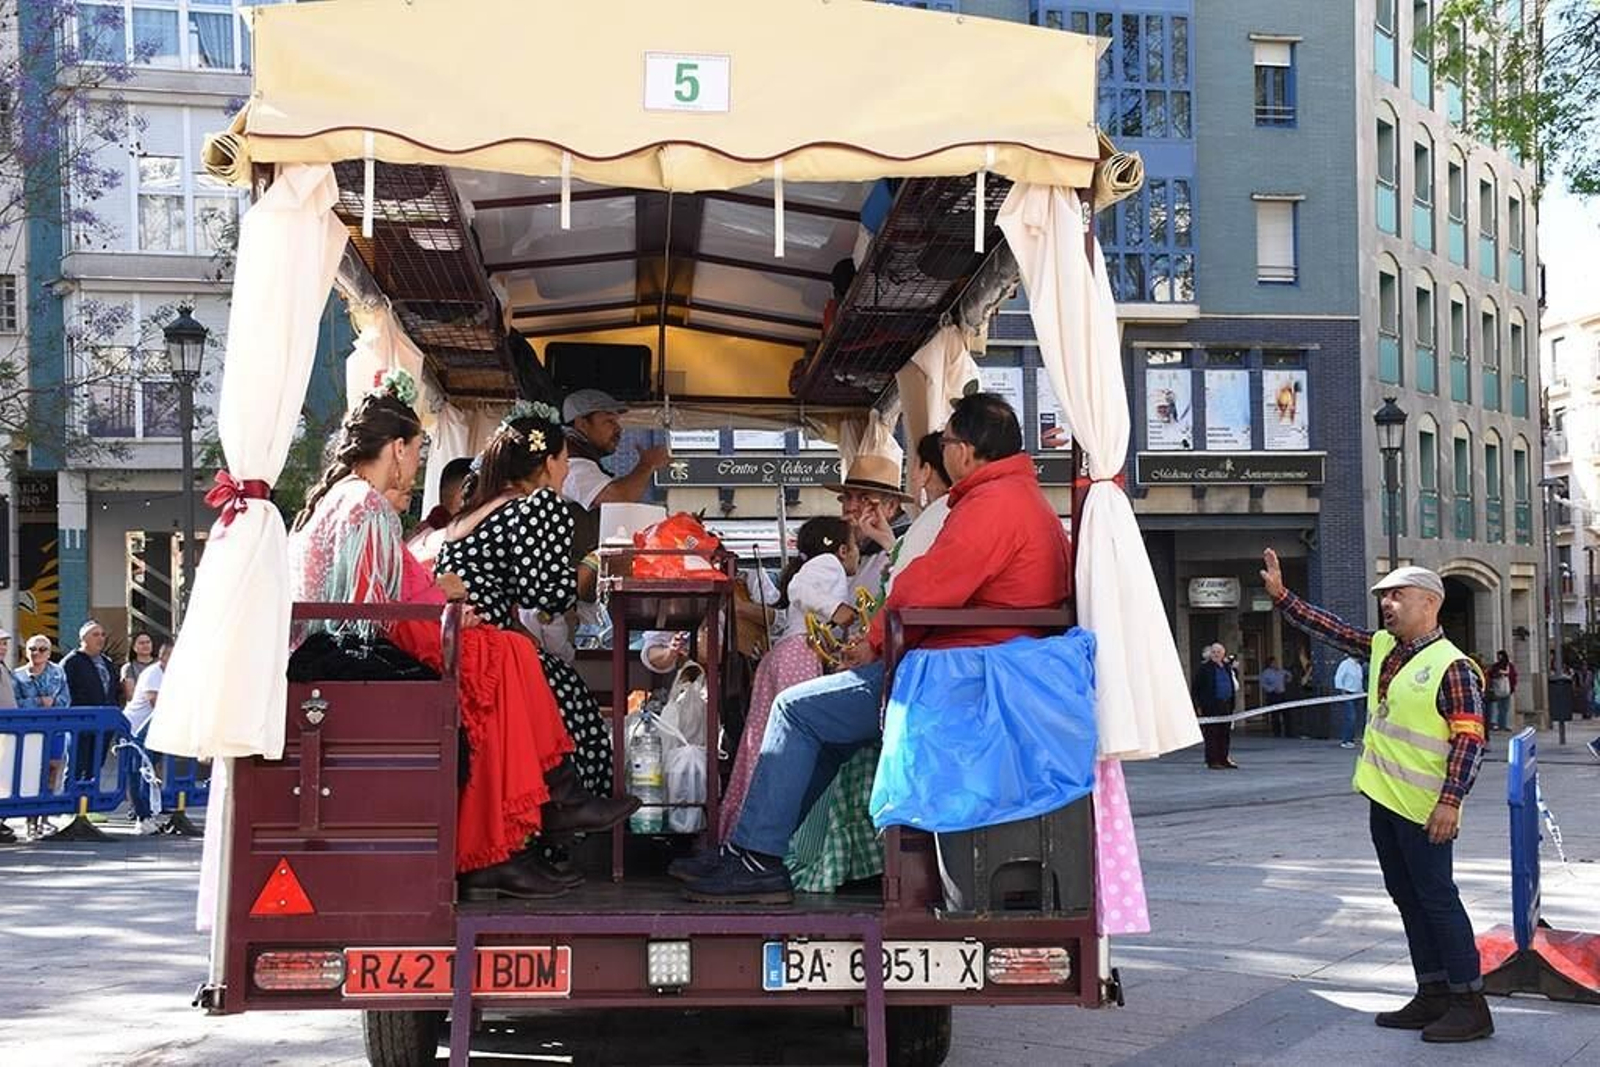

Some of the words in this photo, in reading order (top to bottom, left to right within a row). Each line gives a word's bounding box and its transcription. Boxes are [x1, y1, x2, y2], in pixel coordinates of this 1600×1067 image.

[674, 62, 700, 102] 5
[717, 459, 758, 475] Centro
[815, 460, 829, 475] de
[958, 948, 979, 984] X
